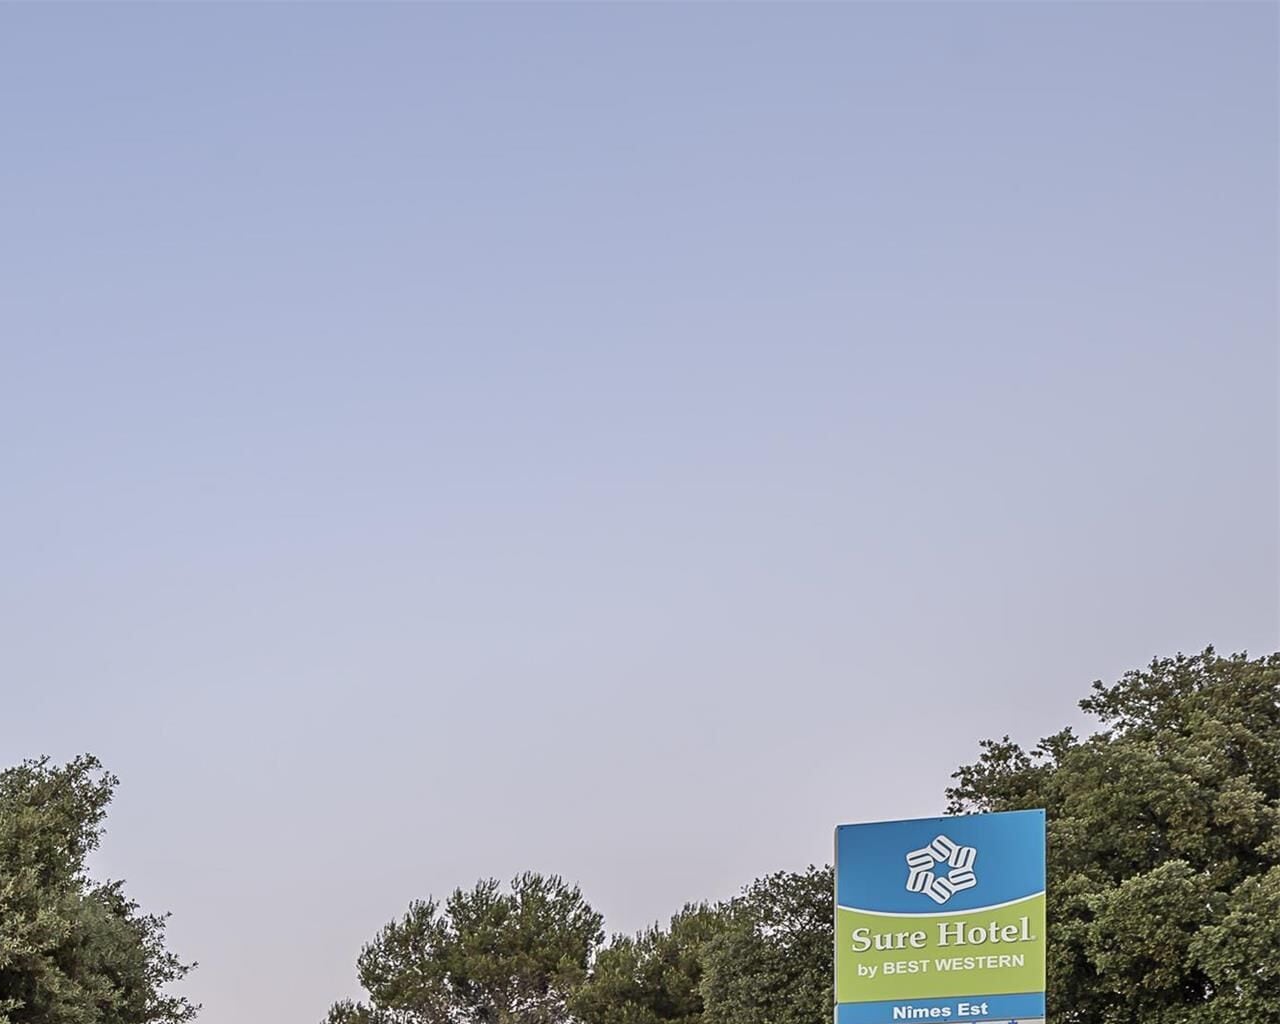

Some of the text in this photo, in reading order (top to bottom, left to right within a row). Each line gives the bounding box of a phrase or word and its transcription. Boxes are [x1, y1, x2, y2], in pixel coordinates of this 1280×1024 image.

[851, 916, 1033, 953] Sure Hotel
[857, 954, 1025, 979] by BEST WESTERN
[893, 1002, 989, 1019] Nîmes Est
